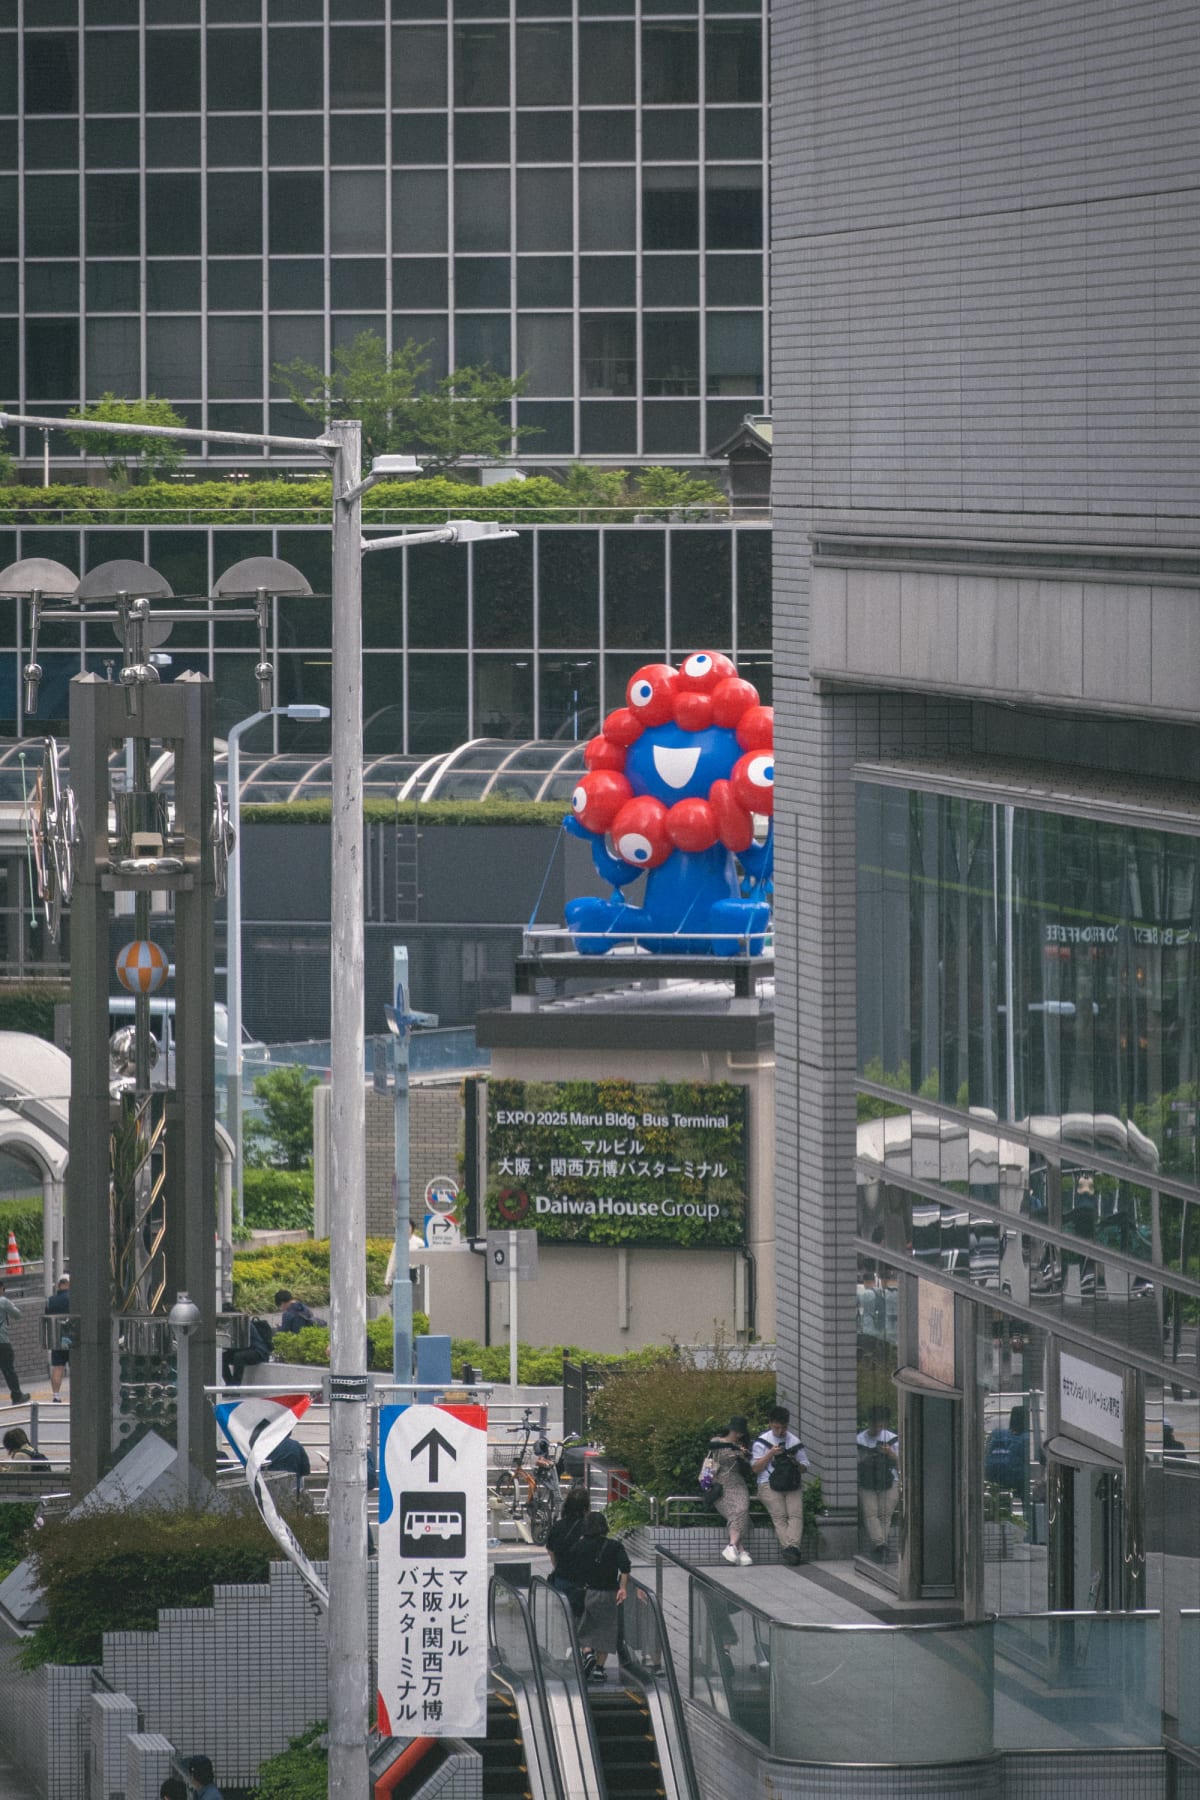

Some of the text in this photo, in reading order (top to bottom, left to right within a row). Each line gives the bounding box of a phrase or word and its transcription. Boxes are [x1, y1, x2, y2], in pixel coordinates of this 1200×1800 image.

[496, 1111, 729, 1130] EXPO 2025 Maru Bldg. Bus Terminal
[581, 1139, 645, 1155] マルビル
[535, 1196, 720, 1222] Daiwa House Group
[448, 1569, 469, 1657] マルビル
[397, 1566, 417, 1721] バスターミナル
[422, 1566, 443, 1721] 大阪・関西万博
